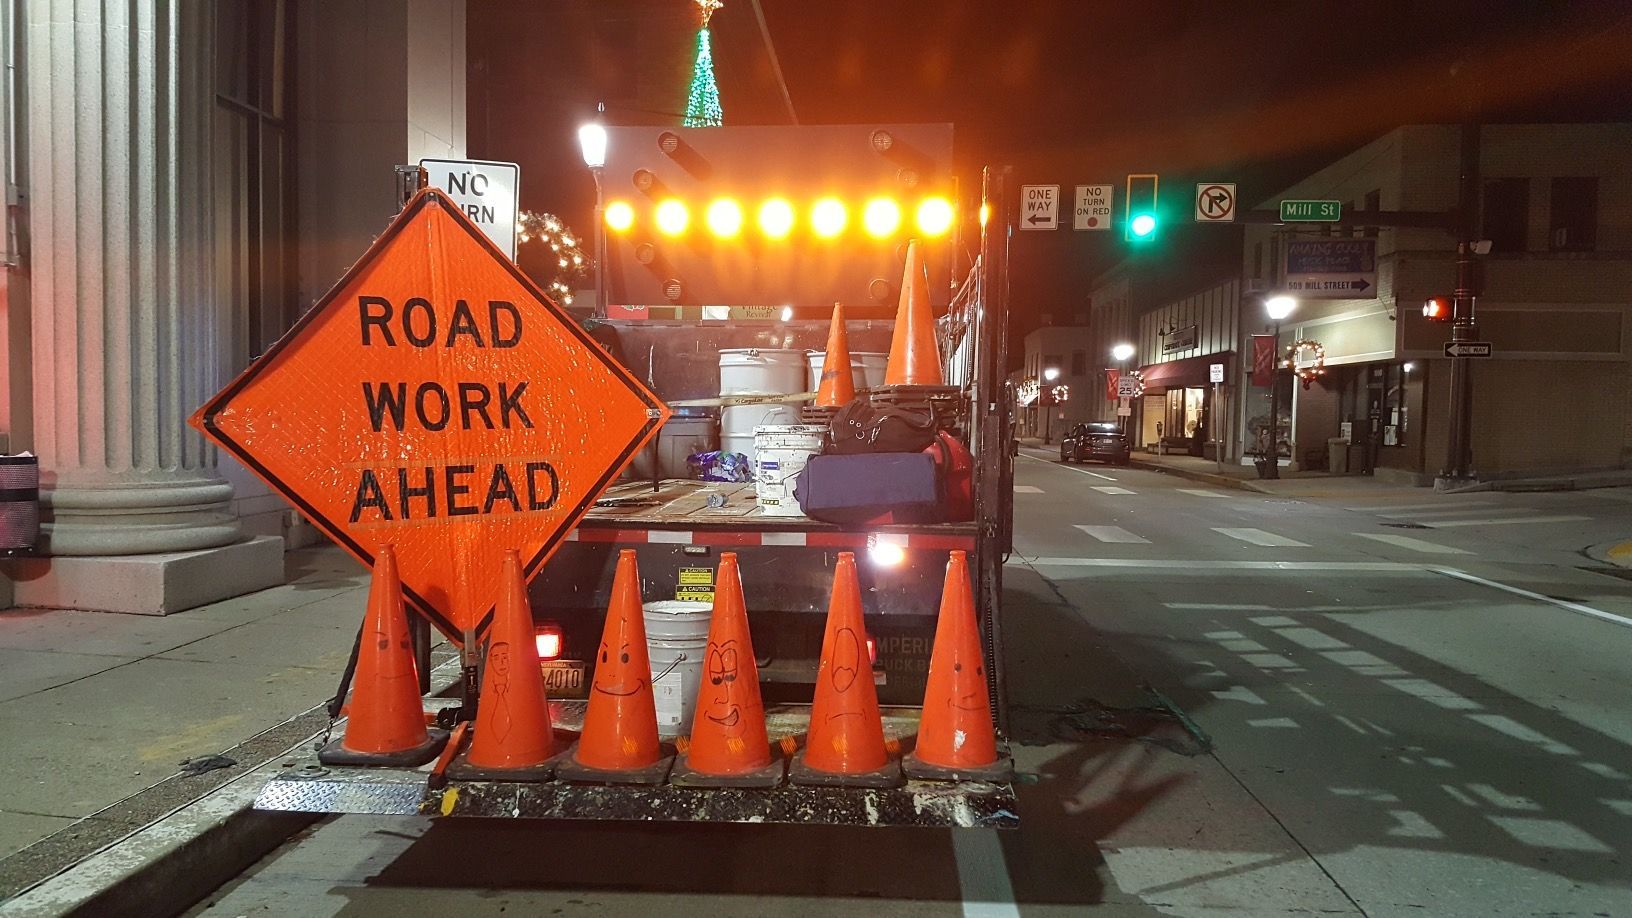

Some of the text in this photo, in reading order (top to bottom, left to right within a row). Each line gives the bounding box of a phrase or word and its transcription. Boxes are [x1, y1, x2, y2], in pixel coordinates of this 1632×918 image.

[447, 171, 489, 197] NO
[1028, 189, 1052, 200] ONE
[1086, 187, 1102, 197] NO
[1027, 201, 1052, 212] WAY
[1083, 198, 1105, 206] TURN
[1076, 207, 1110, 216] ON RED
[1286, 203, 1335, 216] Mill St
[1324, 282, 1350, 290] STREET
[358, 295, 523, 349] ROAD
[1119, 387, 1133, 395] 25
[362, 381, 535, 432] WORK
[348, 461, 561, 523] AHEAD
[545, 669, 580, 689] 4010
